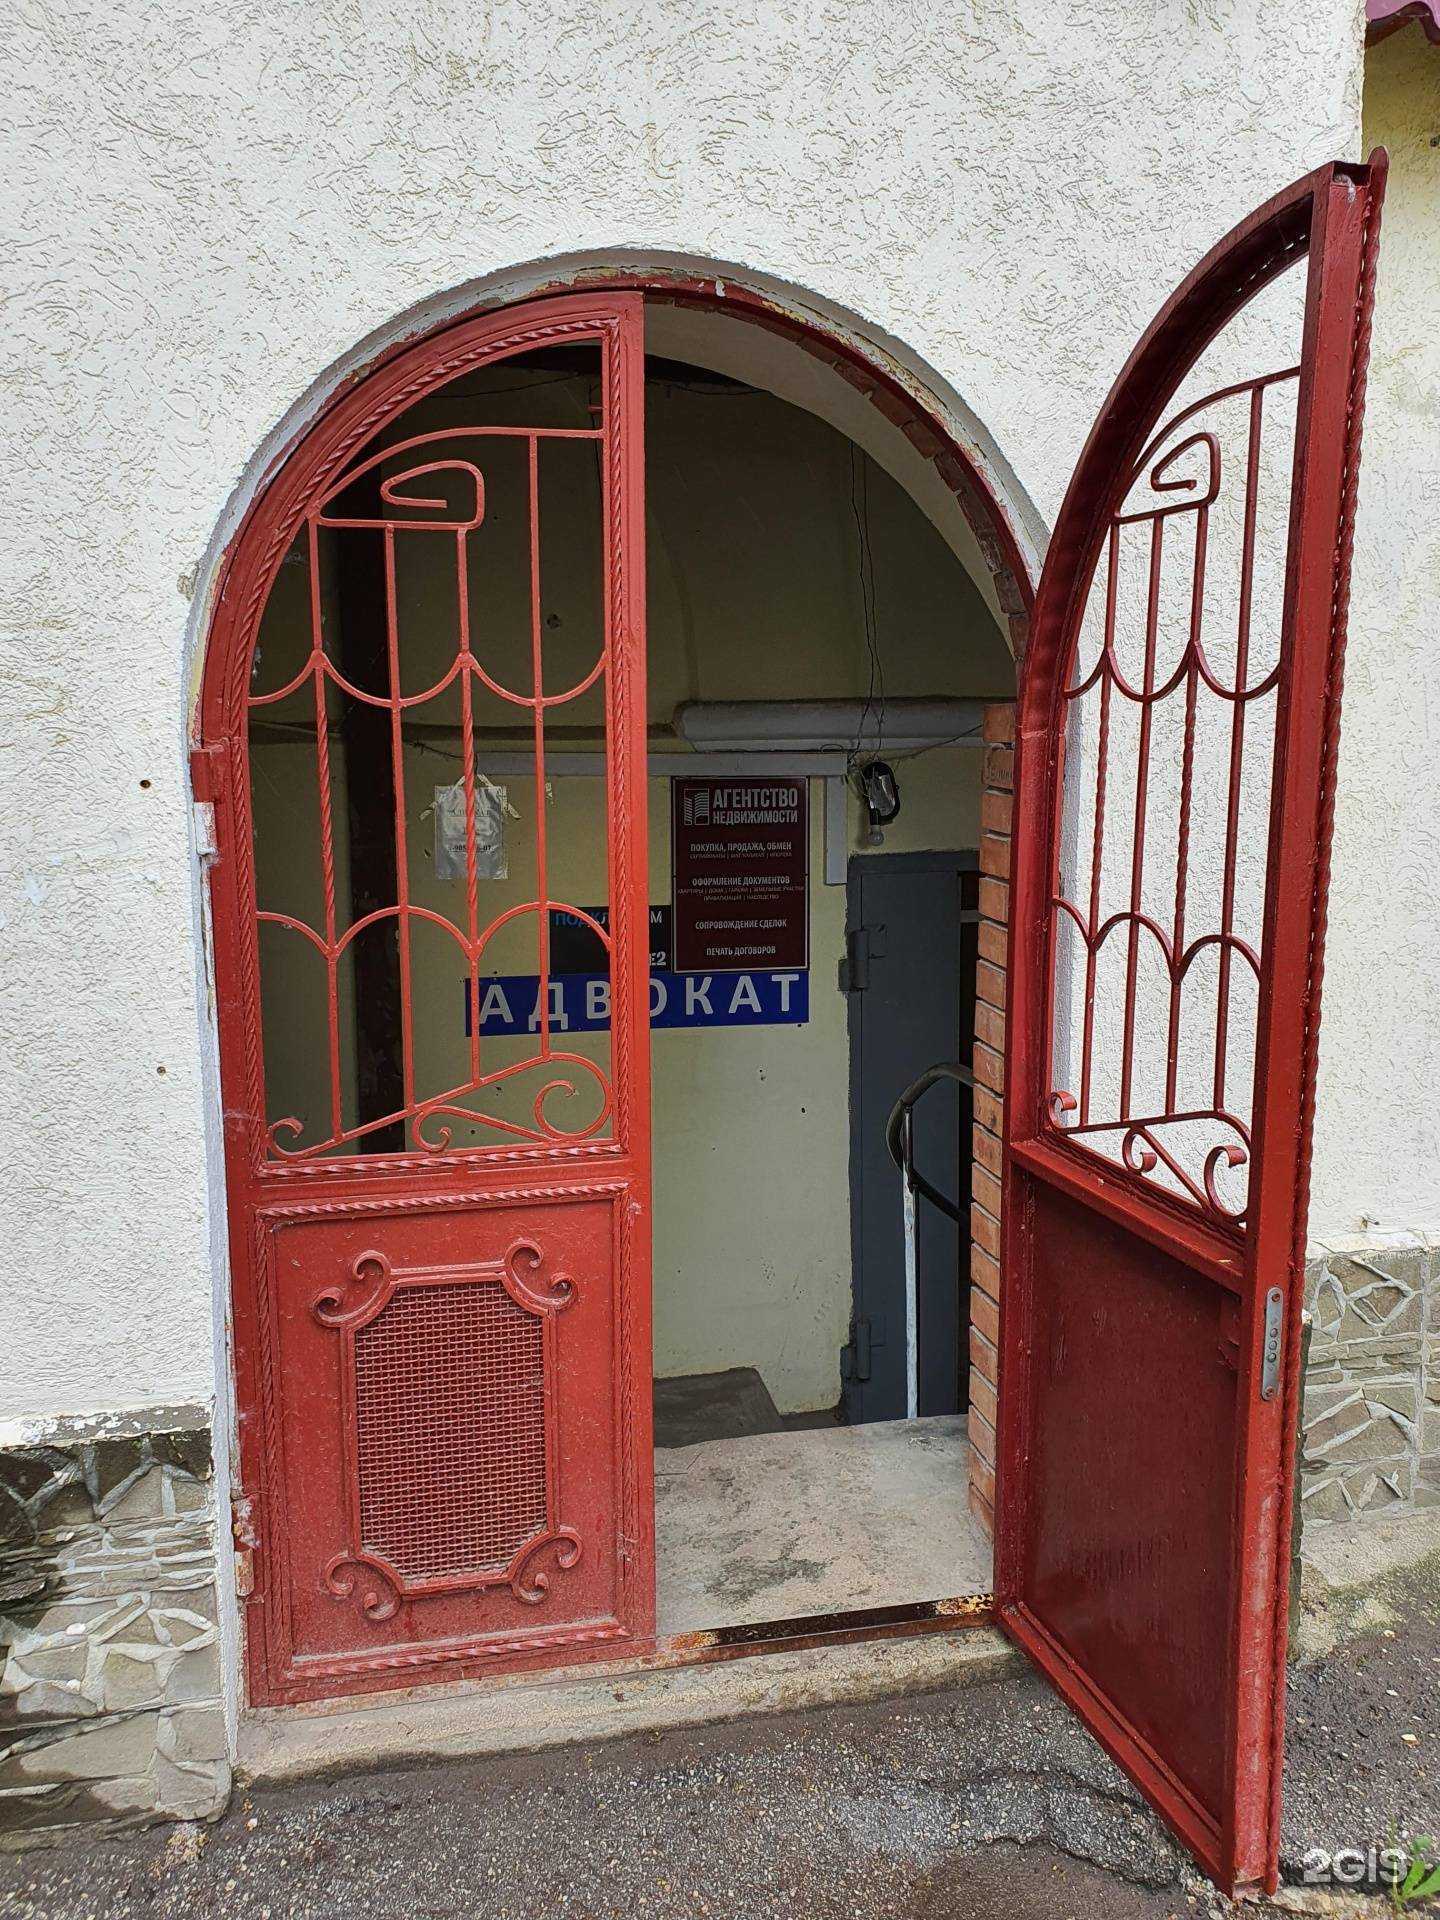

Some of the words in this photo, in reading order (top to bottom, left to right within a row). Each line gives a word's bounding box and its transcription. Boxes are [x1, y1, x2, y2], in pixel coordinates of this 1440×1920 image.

[712, 788, 798, 808] АГЕНТСТВО
[712, 810, 798, 825] НЕДВИЖИМОСТИ
[690, 843, 726, 853] ПОКУПКА,
[727, 842, 766, 853] ПРОДАЖА,
[767, 841, 792, 850] ОБМЕН
[692, 877, 742, 886] ОФОРМЛЕНИЕ
[743, 876, 790, 886] ДОКУМЕНТОВ
[695, 920, 758, 930] СОПРОВОЖДЕНИЕ
[759, 918, 787, 929] СДЕЛОК
[706, 947, 733, 956] ПЕЧАТЬ
[734, 945, 776, 957] ДОГОВОРОВ
[479, 974, 800, 1032] АДВОКАТ
